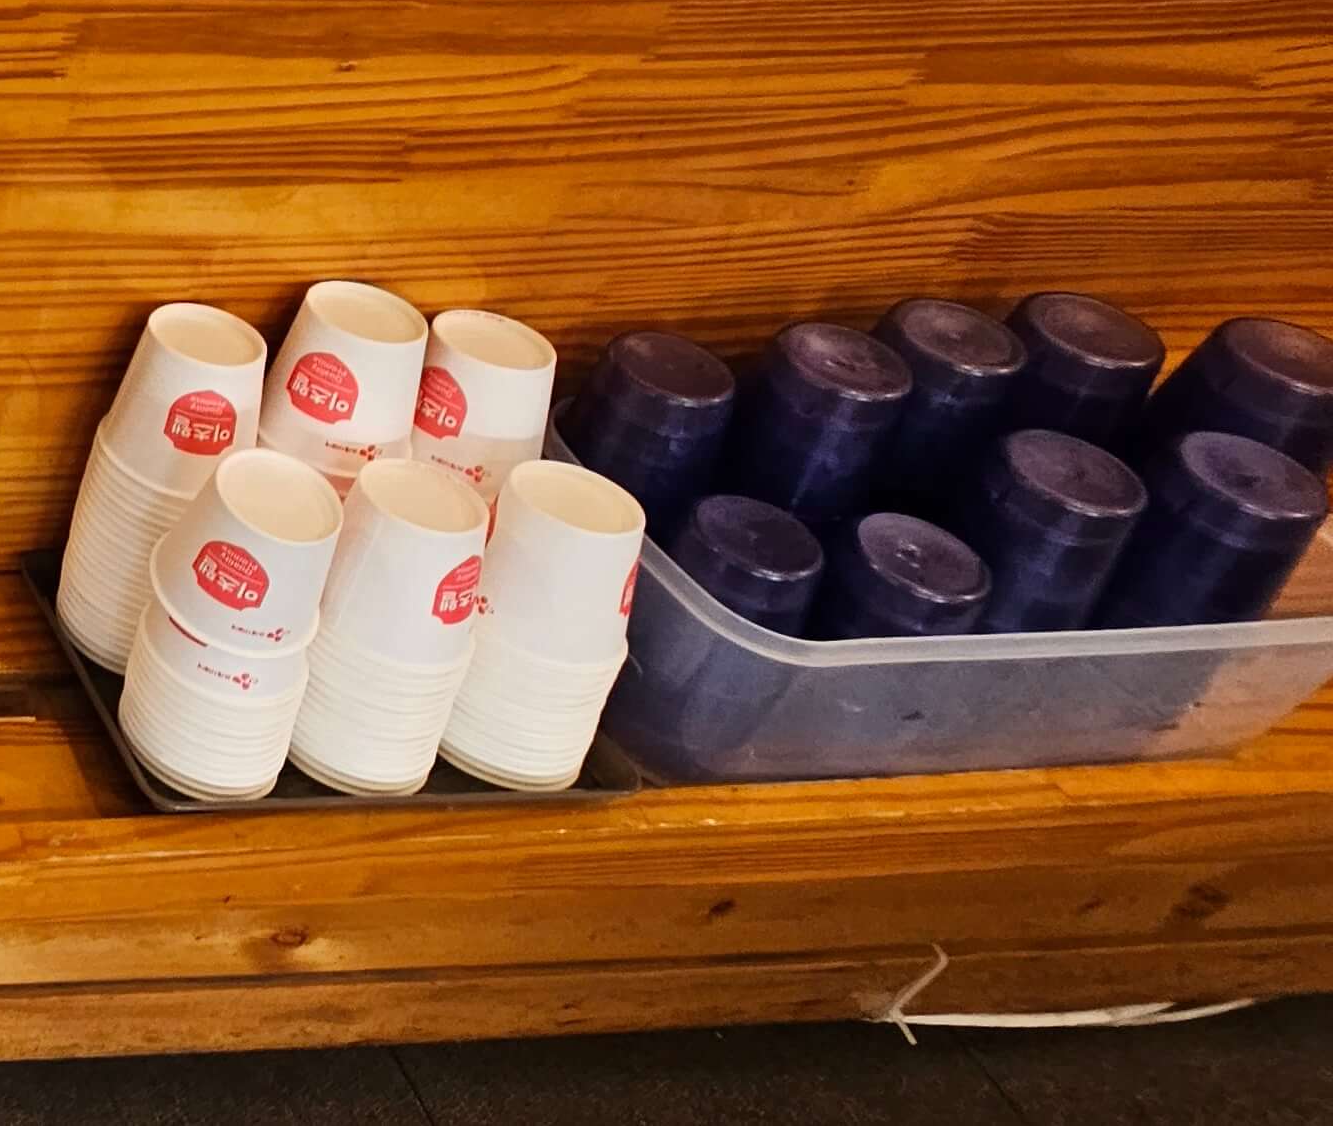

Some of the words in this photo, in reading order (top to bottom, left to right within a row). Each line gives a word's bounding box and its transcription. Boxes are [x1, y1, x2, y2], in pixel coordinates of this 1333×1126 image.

[292, 371, 350, 413] 이츠웰
[418, 390, 458, 429] 이츠
[172, 414, 230, 443] 이츠웰
[199, 554, 259, 601] 이츠웰
[439, 585, 478, 613] 츠웰
